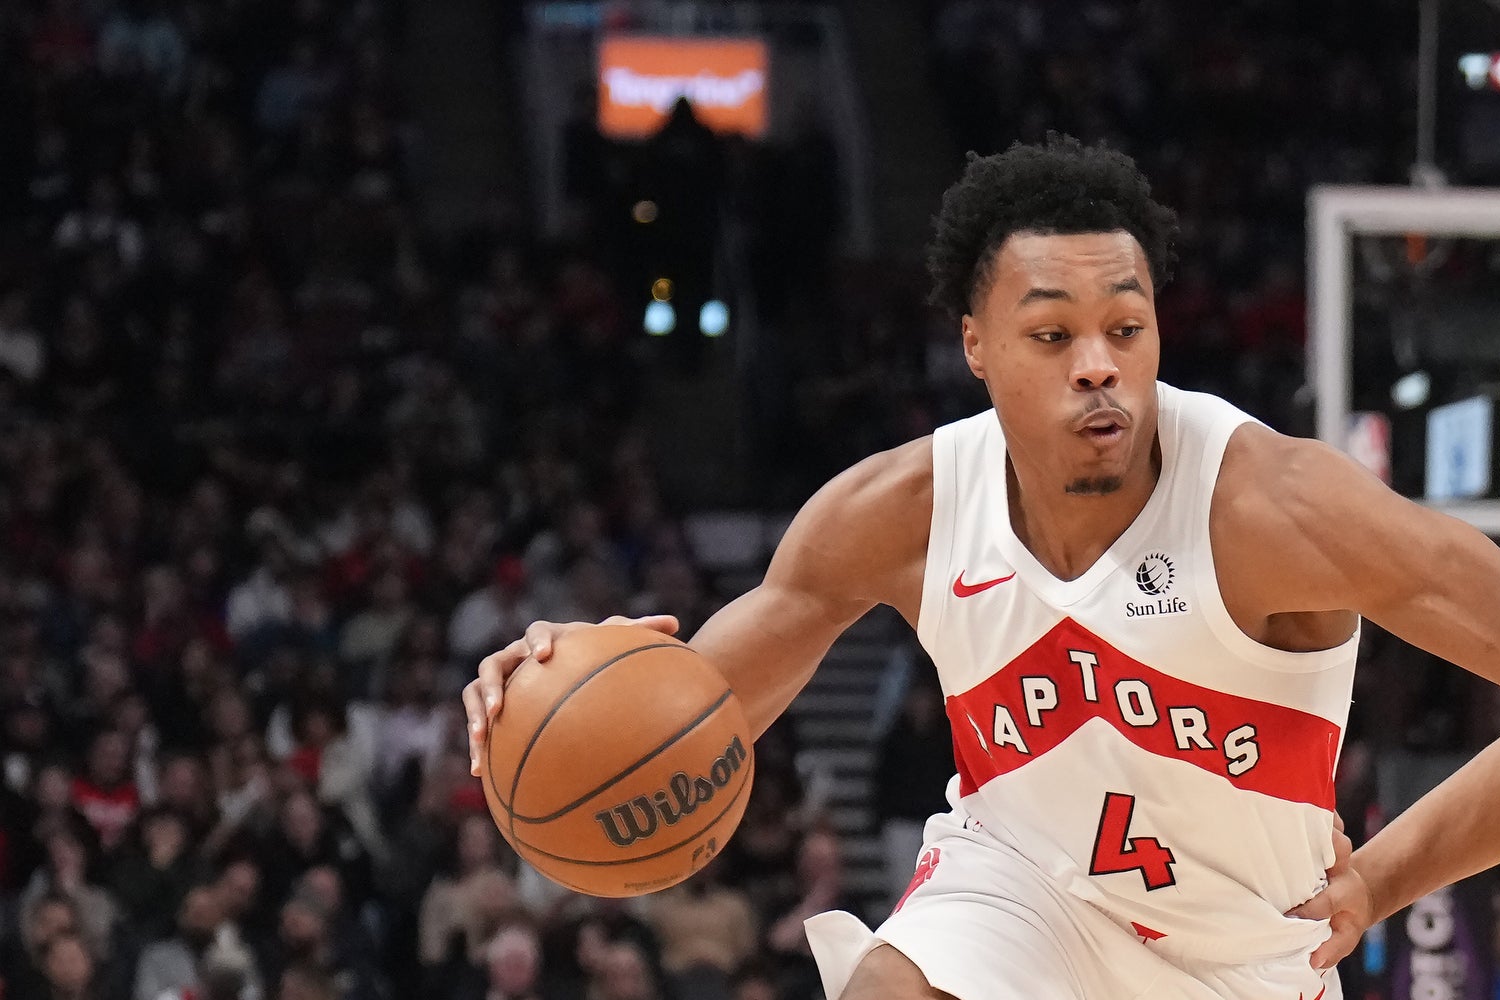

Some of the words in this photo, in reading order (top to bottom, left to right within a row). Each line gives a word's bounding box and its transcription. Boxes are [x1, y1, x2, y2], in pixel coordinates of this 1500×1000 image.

[1126, 602, 1155, 617] Sun
[1158, 597, 1187, 614] Life
[965, 649, 1259, 777] APTORS
[595, 735, 747, 846] Wilson
[1088, 791, 1176, 892] 4
